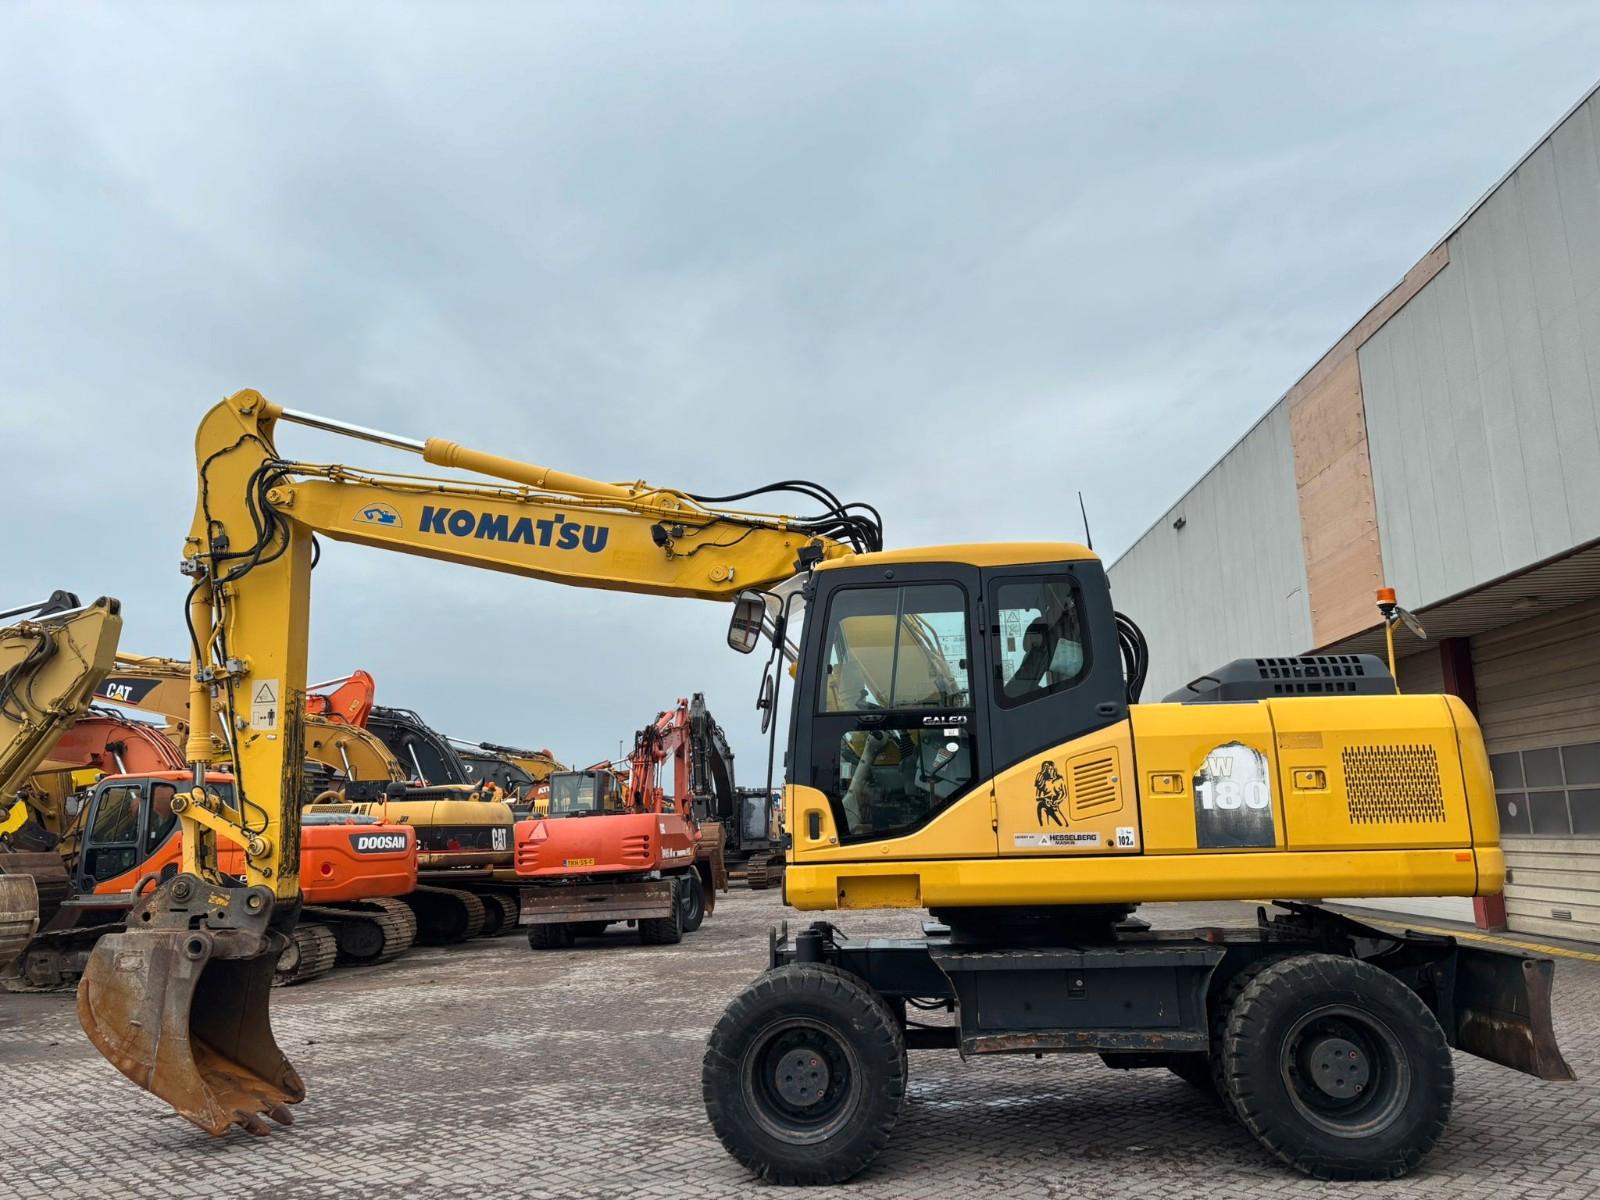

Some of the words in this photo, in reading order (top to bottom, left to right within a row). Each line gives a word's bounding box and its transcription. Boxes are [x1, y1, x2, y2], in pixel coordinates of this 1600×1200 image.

[419, 506, 609, 553] KOMATSU
[107, 683, 132, 701] CAT
[1195, 781, 1269, 809] 180
[358, 836, 405, 850] DOOSAN
[492, 828, 507, 850] CAT
[1118, 835, 1130, 846] 102
